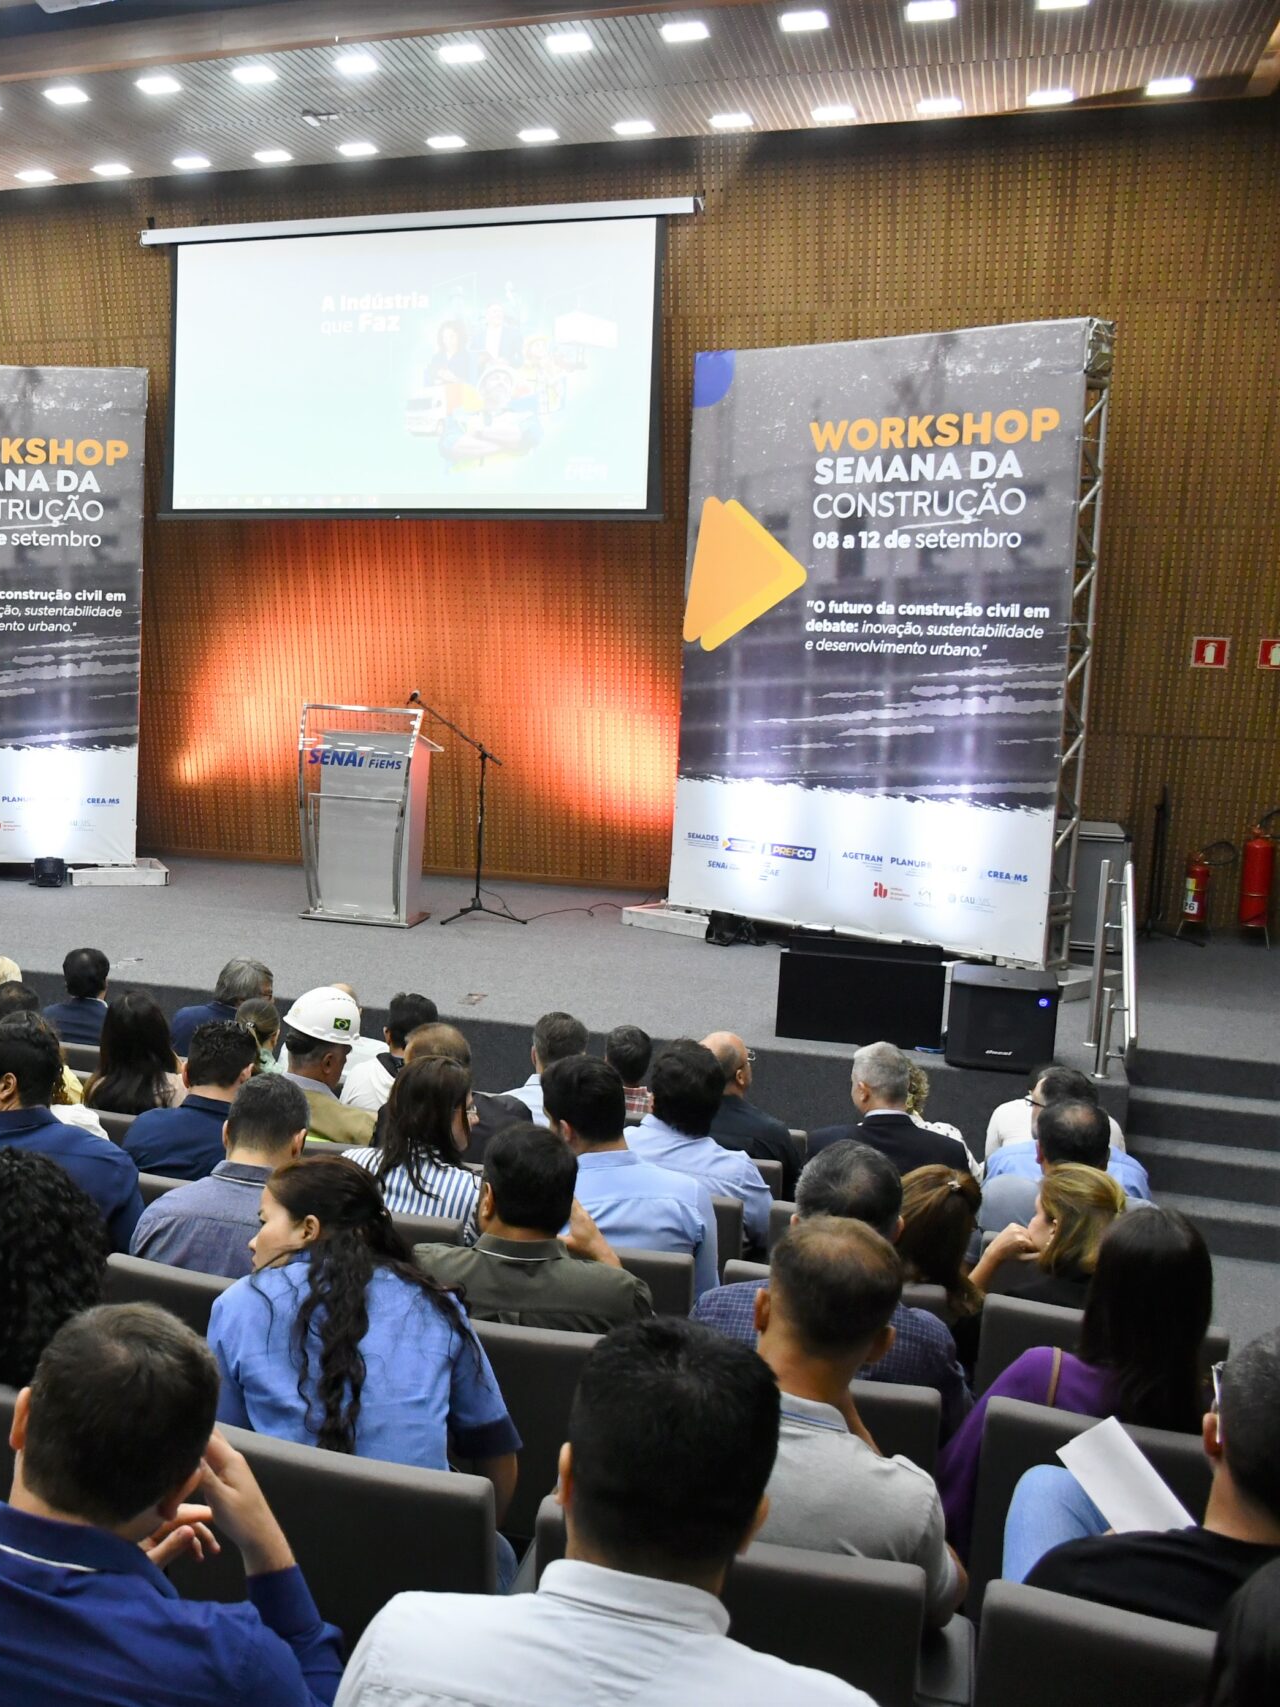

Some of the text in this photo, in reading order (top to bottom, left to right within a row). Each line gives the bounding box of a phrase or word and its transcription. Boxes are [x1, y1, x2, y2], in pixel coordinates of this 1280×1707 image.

[358, 312, 401, 333] Faz
[809, 407, 1061, 453] WORKSHOP
[813, 450, 1023, 485] SEMANA DA
[56, 470, 101, 493] DA
[813, 482, 1026, 525] CONSTRUÇÃO
[10, 530, 101, 547] setembro
[813, 528, 1021, 549] 08 a 12 de setembro
[75, 589, 102, 602] civil
[105, 592, 126, 602] em
[24, 605, 122, 617] sustentabilidade
[807, 601, 1050, 619] "O futuro da construção civil em
[28, 620, 77, 633] urbano."
[805, 619, 1044, 639] debate: inovação, sustentabilidade
[805, 639, 988, 657] e desenvolvimento urbano."
[687, 832, 720, 842] SEMADES
[842, 851, 883, 863] AGETRAN
